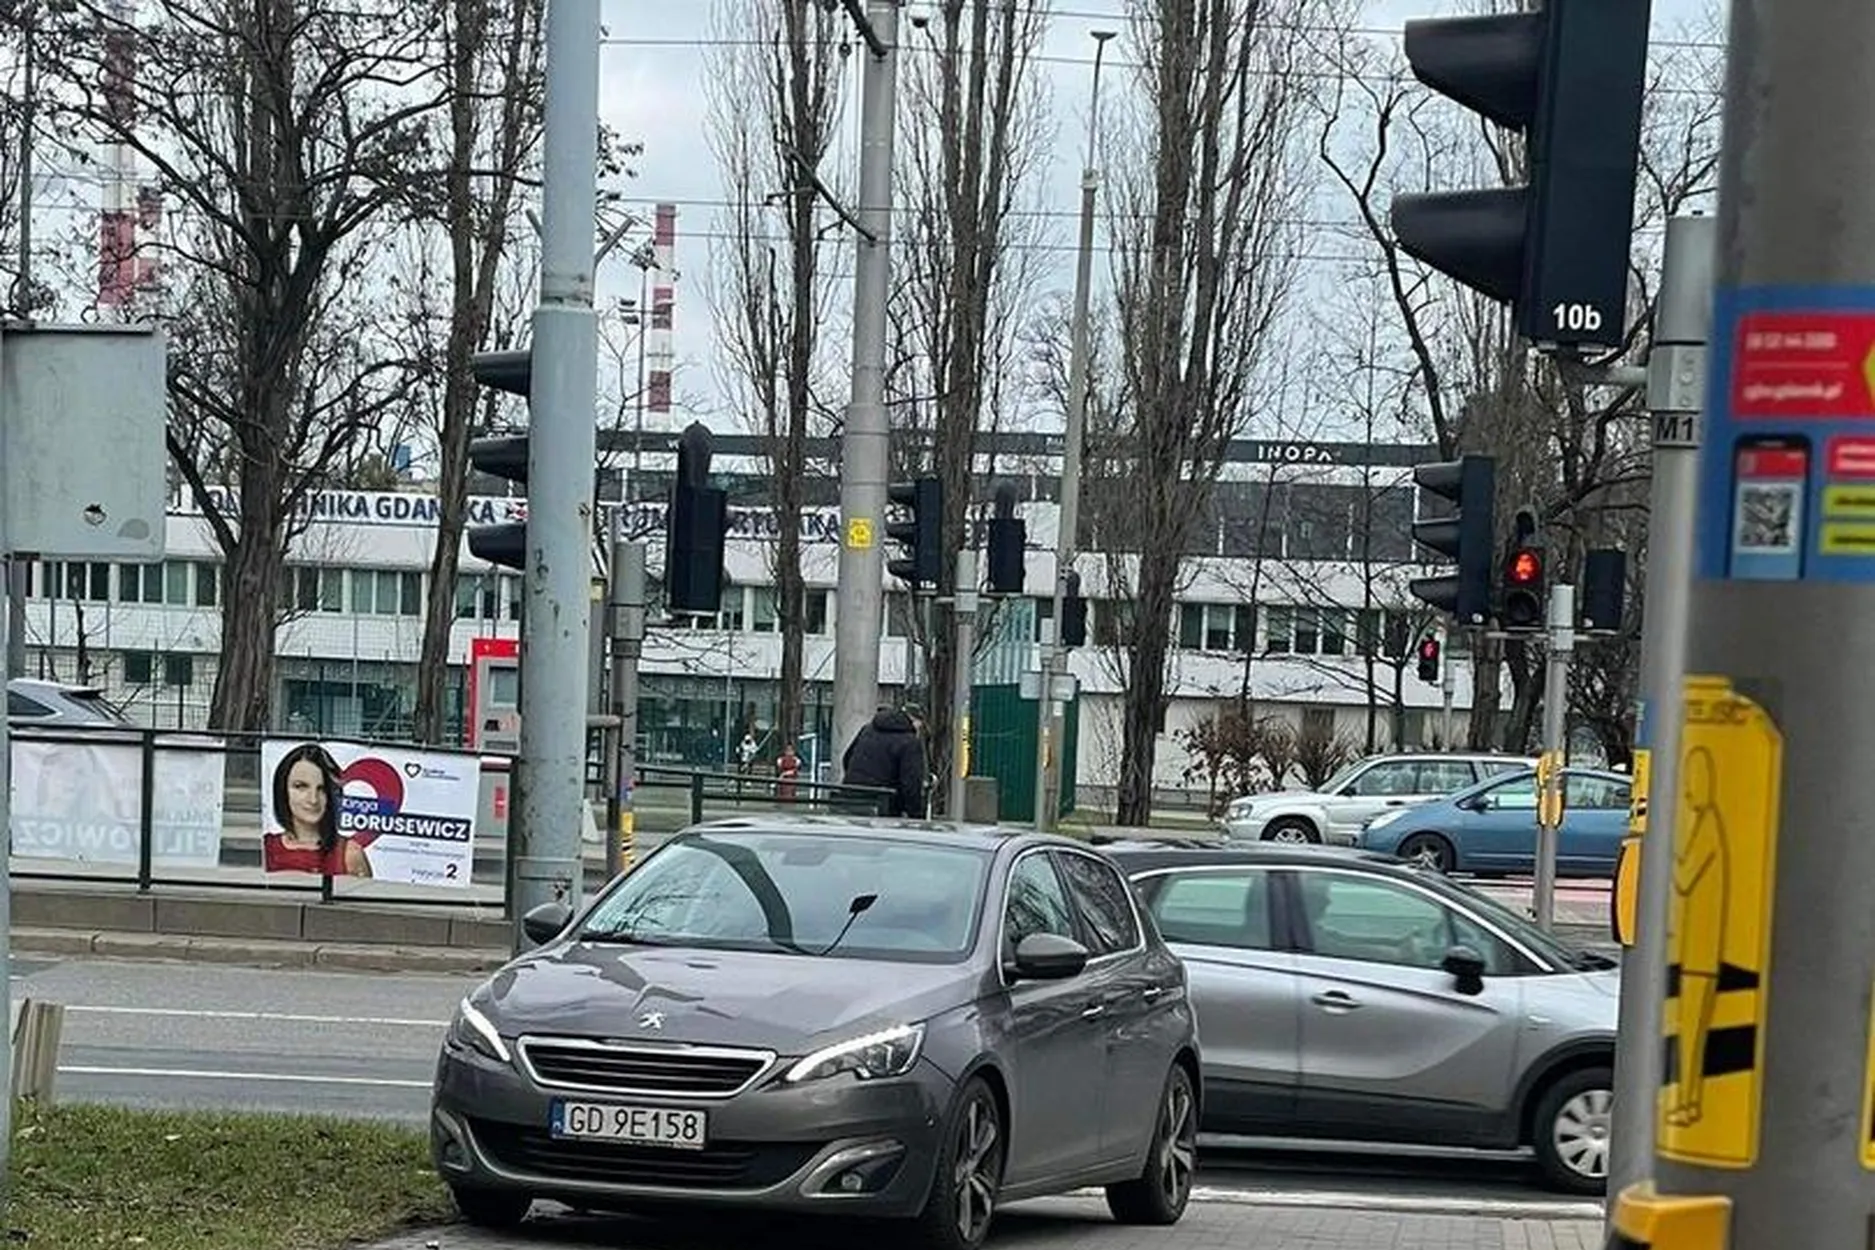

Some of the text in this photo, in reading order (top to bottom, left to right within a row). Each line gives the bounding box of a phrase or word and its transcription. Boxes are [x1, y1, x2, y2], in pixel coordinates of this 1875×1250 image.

[1552, 303, 1601, 331] 10b
[1655, 419, 1694, 440] M1
[375, 496, 496, 524] GDAKA
[340, 812, 467, 840] BORUSEWICZ
[446, 863, 458, 880] 2
[570, 1106, 603, 1133] GD
[614, 1109, 698, 1140] 9E158
